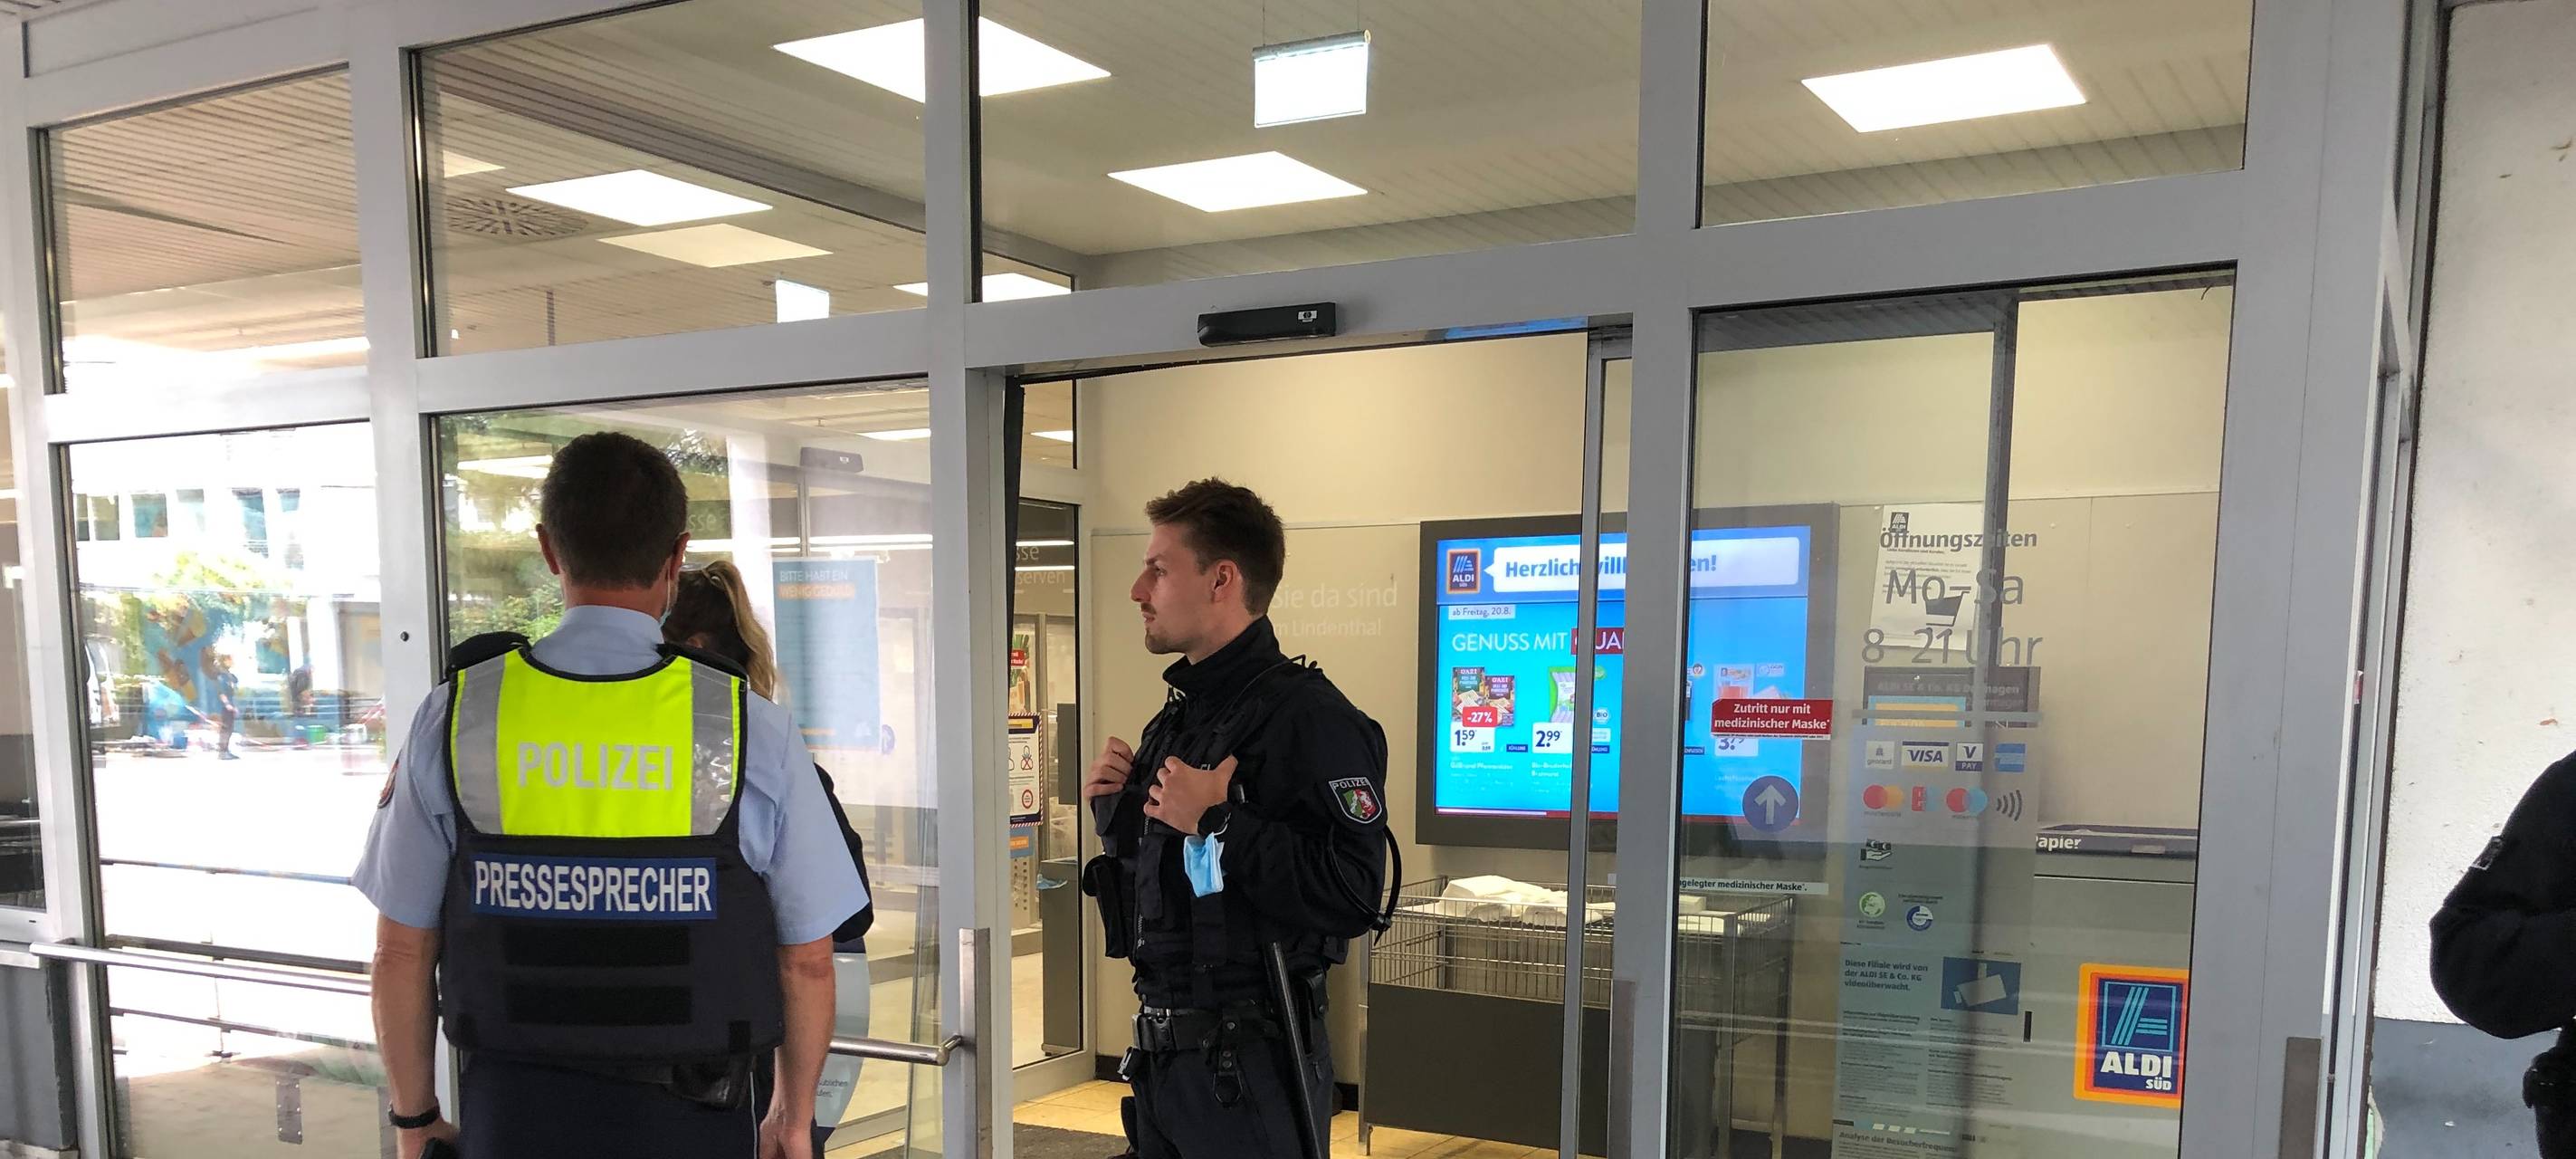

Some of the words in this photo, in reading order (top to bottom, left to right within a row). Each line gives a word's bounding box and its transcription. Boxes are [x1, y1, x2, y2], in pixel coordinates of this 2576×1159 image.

[1880, 527, 2037, 552] Öffnungsziten
[1505, 557, 1579, 578] Herzlich
[779, 570, 804, 581] BITTE
[1452, 573, 1474, 583] ALDI
[1311, 582, 1340, 608] da
[1346, 580, 1398, 608] sind
[1452, 608, 1461, 616] ab
[1491, 608, 1511, 616] 20.8.
[1452, 632, 1530, 652] GENUSS
[1533, 631, 1568, 650] MIT
[1965, 627, 2043, 666] Uhr
[1733, 703, 1768, 714] Zutritt
[1770, 704, 1791, 714] nur
[1792, 704, 1811, 714] mit
[1466, 712, 1493, 723] -27%
[1714, 717, 1789, 729] medizinischer
[1906, 749, 1943, 762] VISA
[1963, 745, 1977, 759] V
[518, 742, 673, 790] POLIZEI
[2036, 835, 2082, 852] apier
[474, 860, 711, 912] PRESSESPRECHER
[1717, 880, 1774, 890] medizinischer
[1845, 959, 1866, 968] Diese
[1867, 960, 1892, 970] Filiale
[1893, 962, 1911, 972] wird
[1860, 971, 1877, 979] ALDI
[1911, 973, 1922, 982] KG
[2100, 1051, 2172, 1079] ALDI
[2145, 1078, 2172, 1091] SÜD
